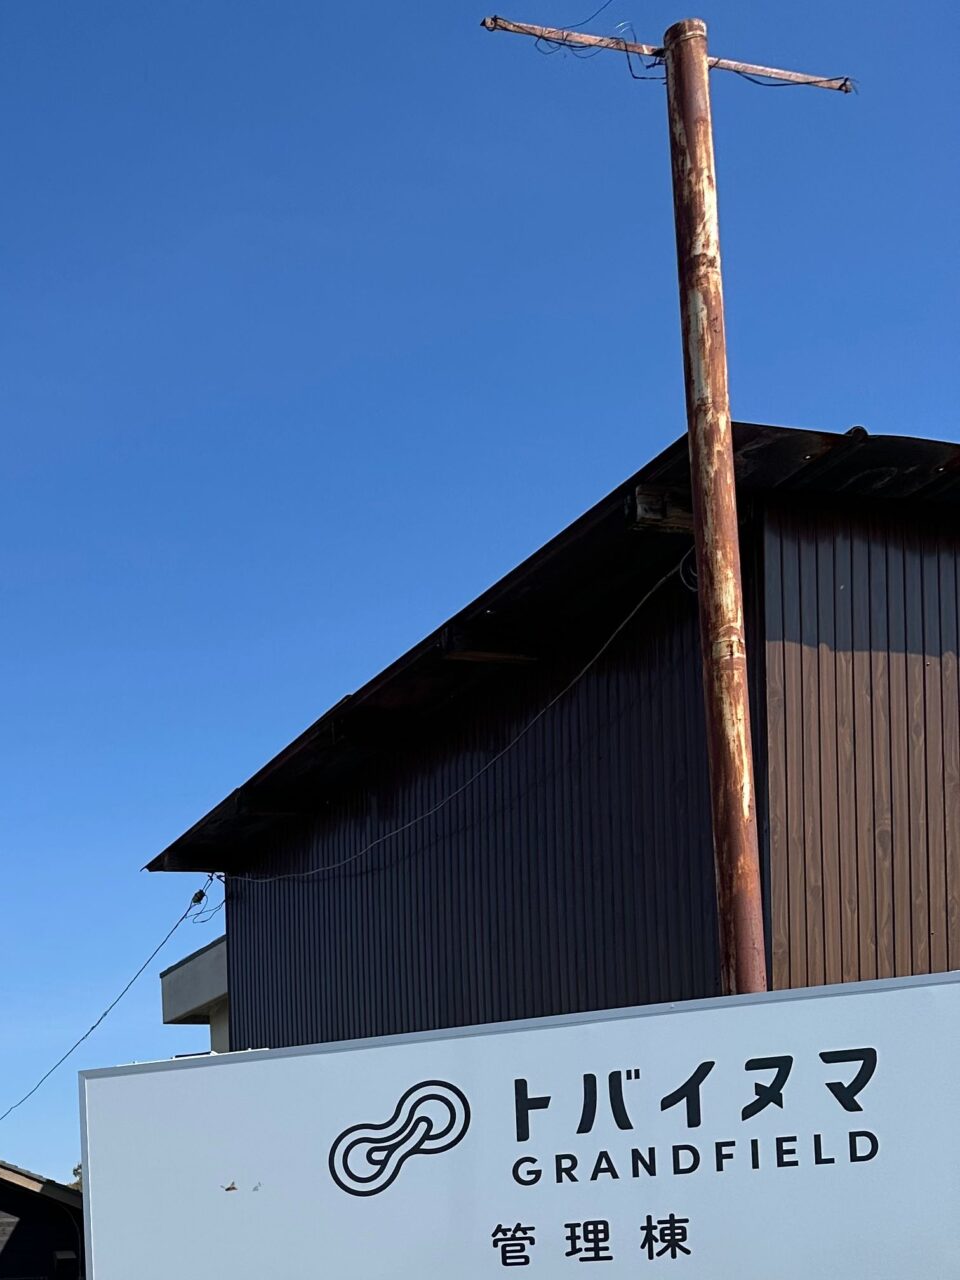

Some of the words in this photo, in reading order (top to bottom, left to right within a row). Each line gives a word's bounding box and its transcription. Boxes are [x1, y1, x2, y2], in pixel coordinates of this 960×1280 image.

[514, 1047, 879, 1143] トバイヌマ
[511, 1130, 879, 1187] GRANDFIELD
[491, 1213, 692, 1267] 管理棟
